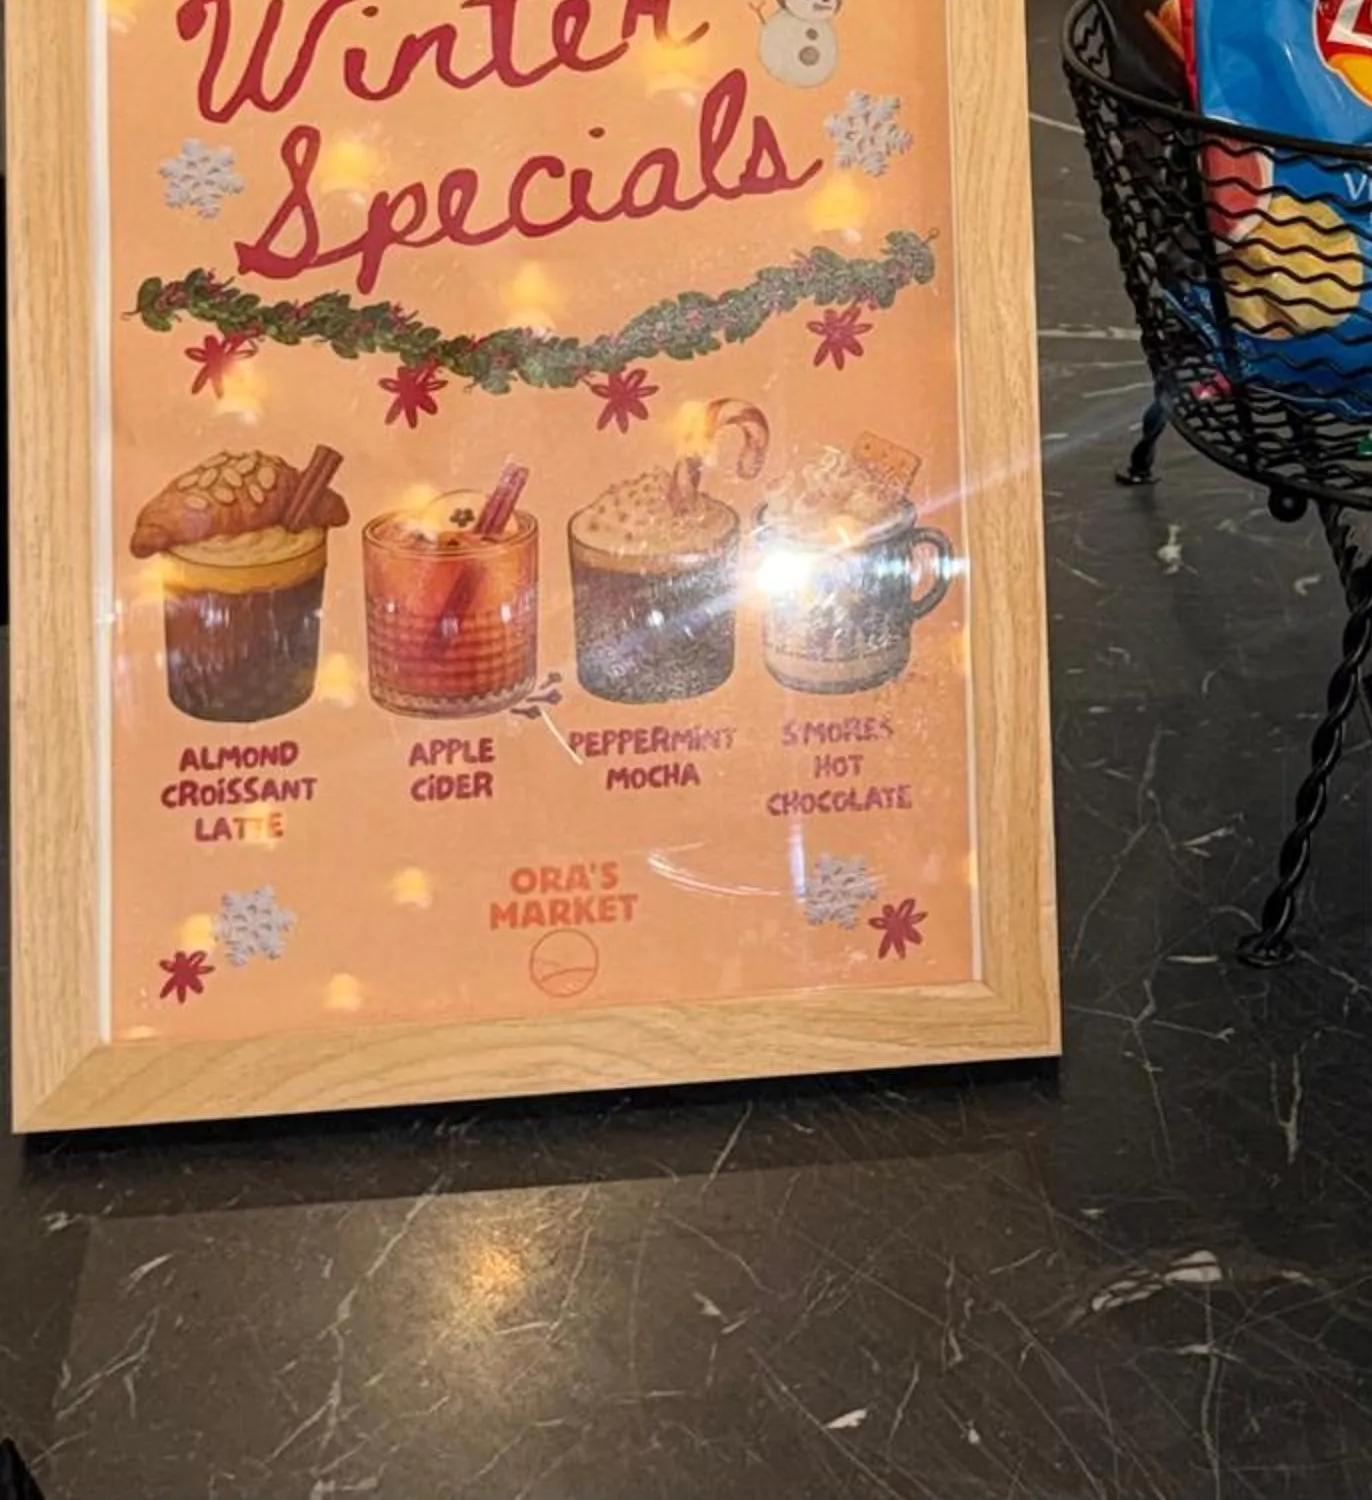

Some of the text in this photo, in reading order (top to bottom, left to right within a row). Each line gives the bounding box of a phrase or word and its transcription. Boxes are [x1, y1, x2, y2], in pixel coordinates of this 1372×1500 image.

[237, 69, 824, 294] Specials
[179, 740, 299, 773] ALMOND
[409, 737, 495, 768] APPLE
[814, 753, 864, 779] HOT
[606, 762, 701, 791] MOCHA
[766, 784, 913, 817] CHOCOLATE
[510, 861, 619, 895] ORA'S
[490, 894, 639, 931] MARKET
